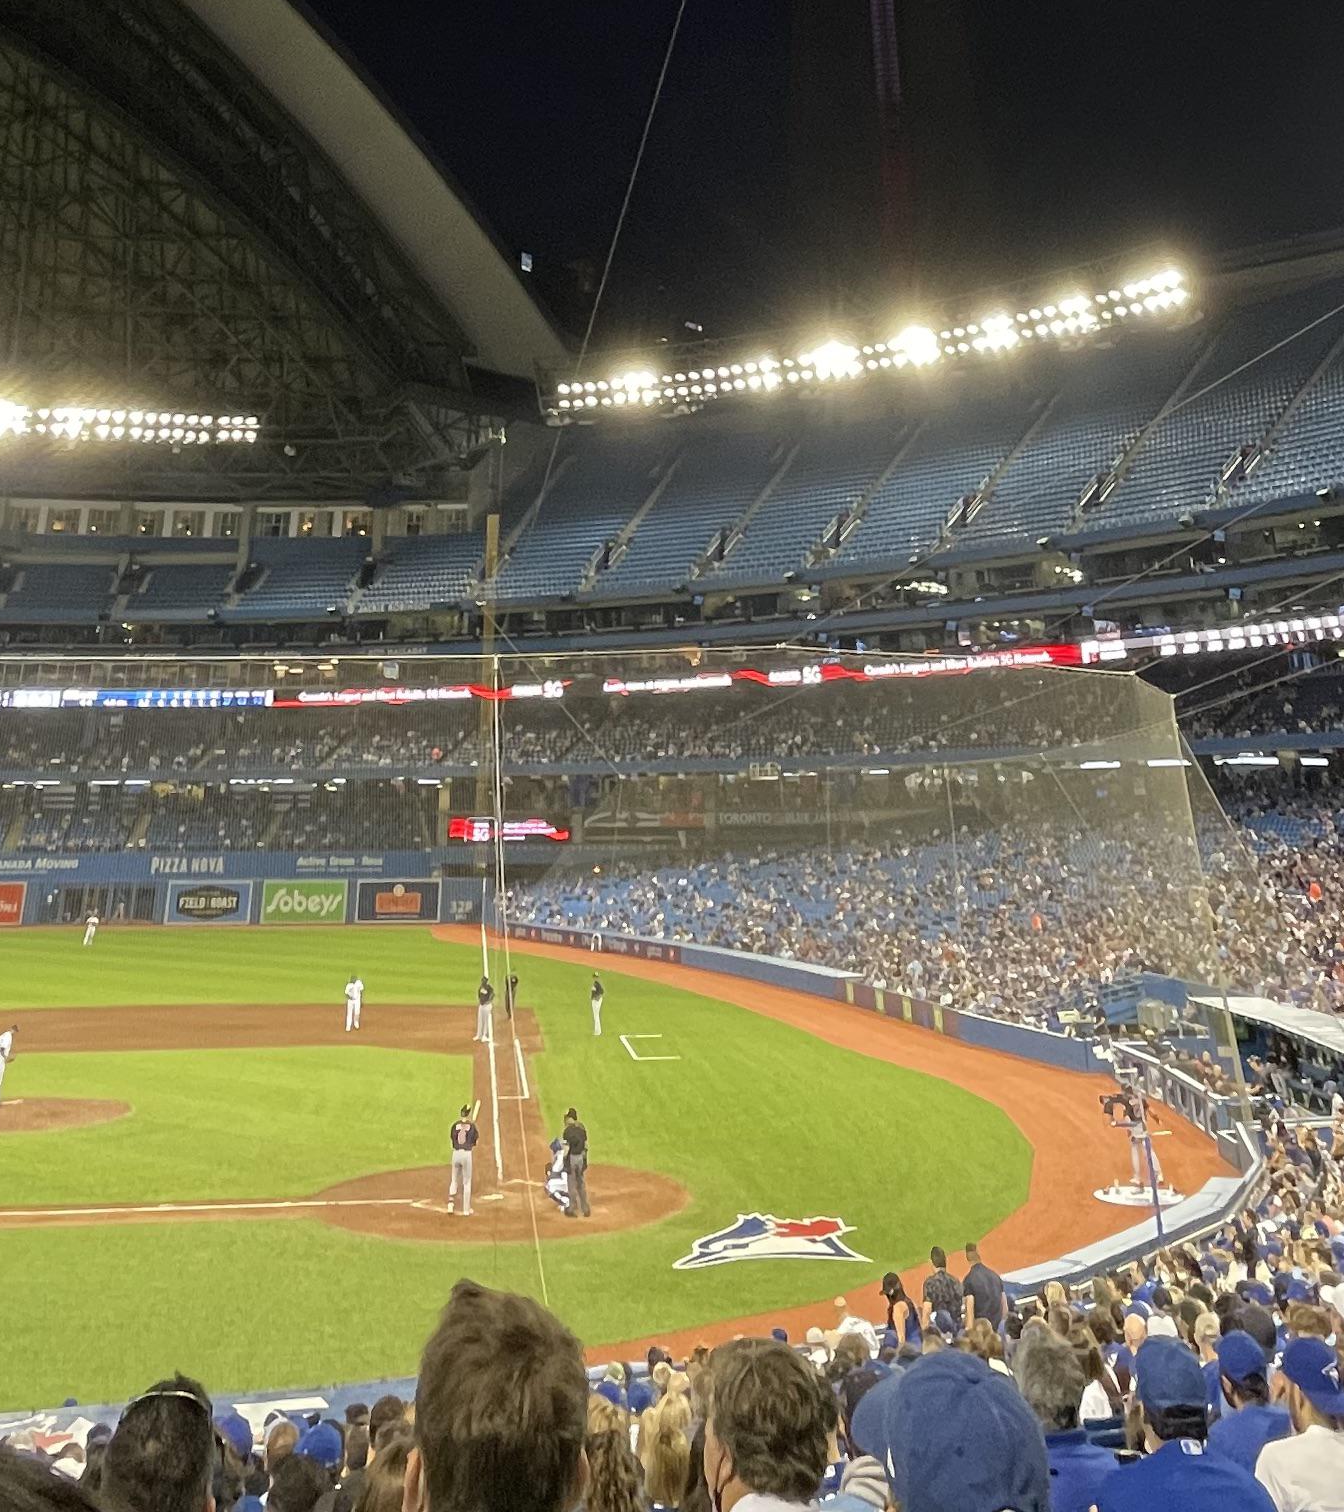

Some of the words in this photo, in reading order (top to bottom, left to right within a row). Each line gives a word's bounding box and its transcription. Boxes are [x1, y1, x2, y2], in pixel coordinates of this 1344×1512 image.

[151, 856, 188, 874] PIZZA
[191, 856, 225, 874] NOVA
[266, 888, 344, 916] Sobeys
